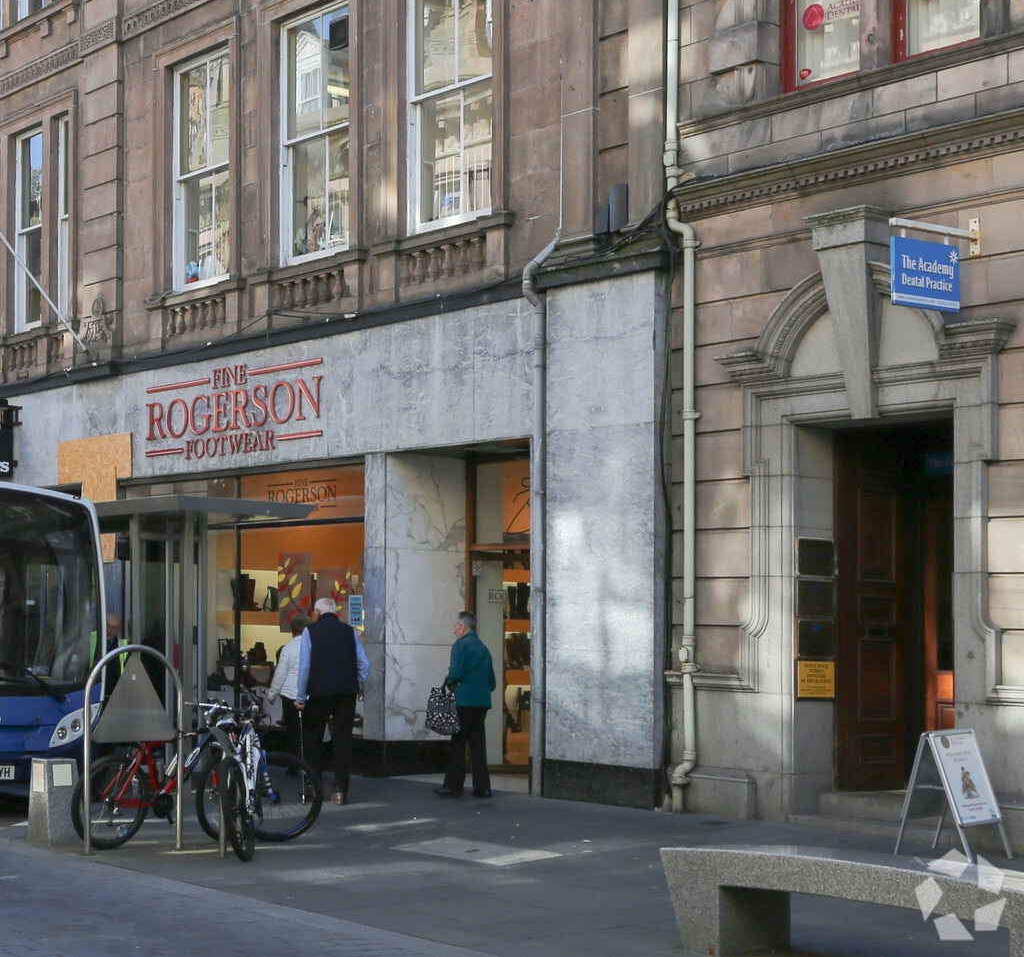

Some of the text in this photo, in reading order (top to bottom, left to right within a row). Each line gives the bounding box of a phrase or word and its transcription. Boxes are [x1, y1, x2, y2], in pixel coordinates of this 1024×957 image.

[901, 254, 954, 279] The Academy
[901, 273, 953, 292] Dental Practice
[211, 364, 247, 389] FINE
[145, 376, 323, 440] ROGERSON
[185, 430, 276, 460] FOOTWEAR
[267, 485, 337, 503] ROGERSON
[294, 478, 308, 487] FINE
